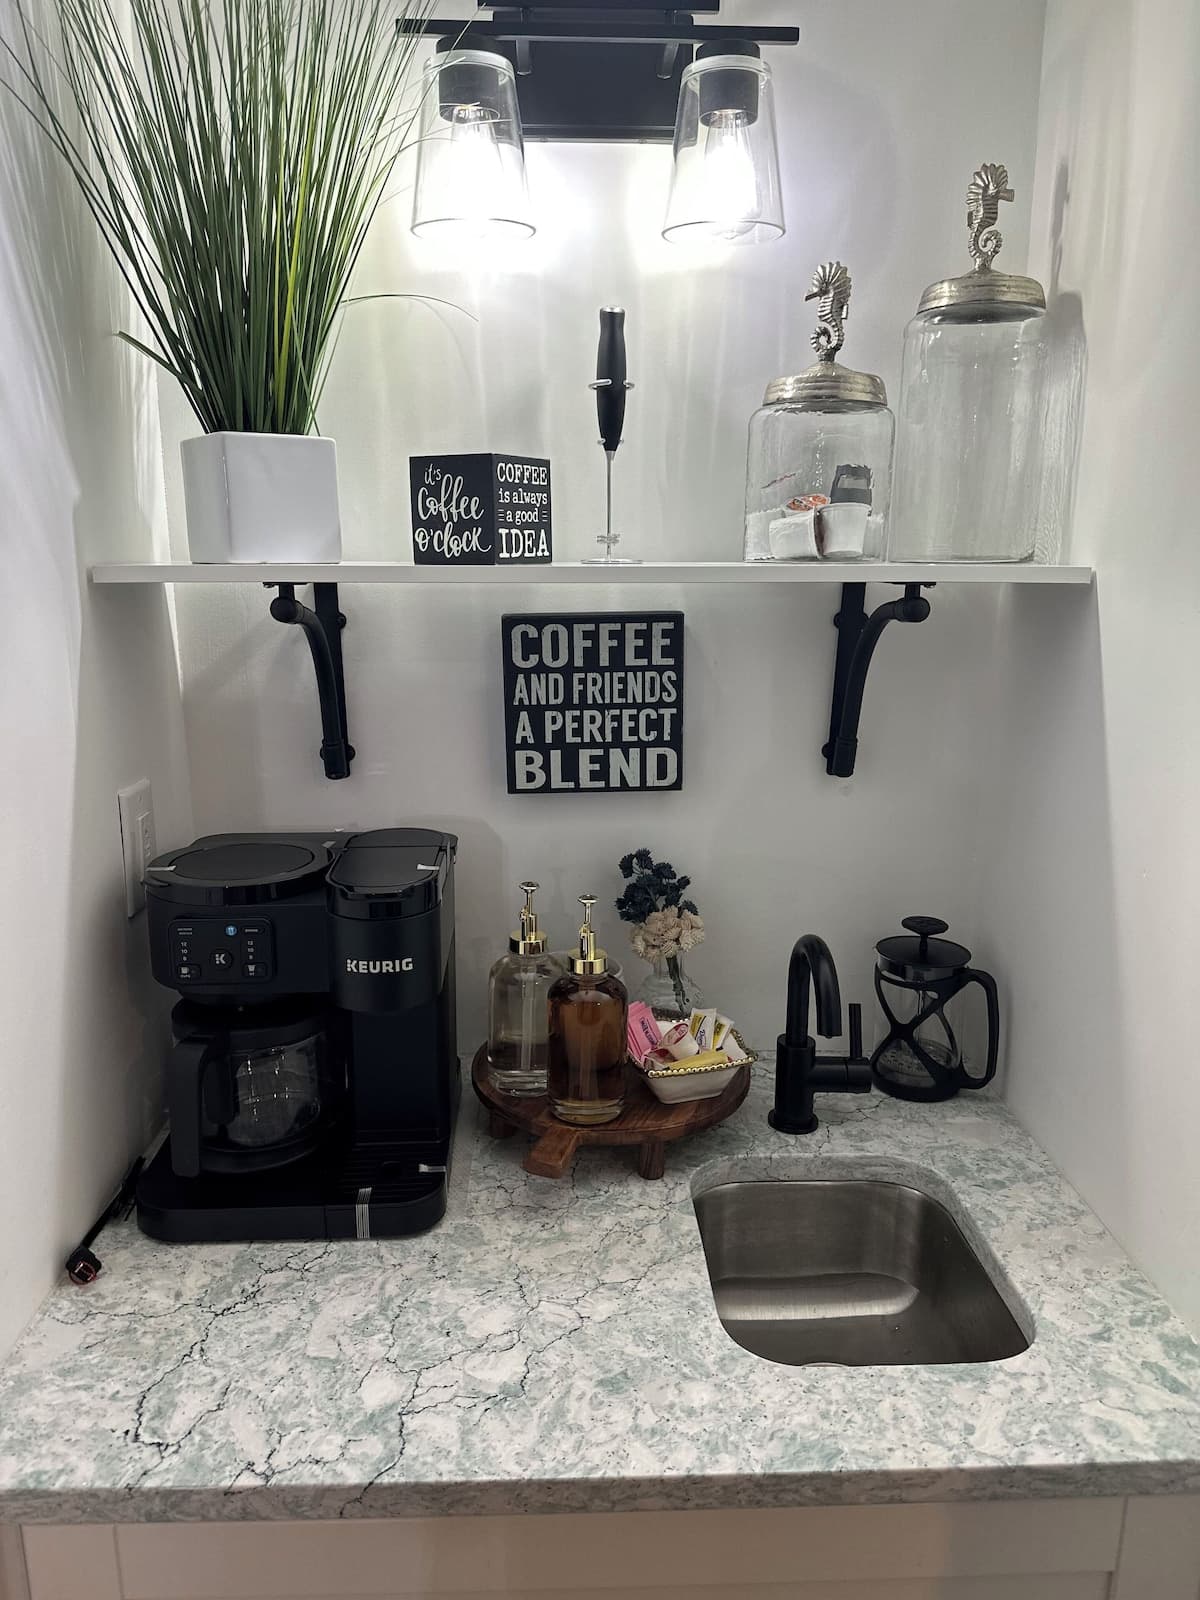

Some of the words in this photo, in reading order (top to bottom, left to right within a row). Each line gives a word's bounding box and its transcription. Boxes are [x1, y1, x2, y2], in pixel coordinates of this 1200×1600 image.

[424, 463, 442, 486] it's
[496, 462, 548, 485] COFFEE
[417, 473, 485, 523] Coffee
[498, 487, 511, 504] is
[512, 487, 548, 508] always
[506, 512, 514, 522] a
[514, 507, 540, 526] good
[498, 528, 550, 559] IDEA
[510, 621, 675, 669] COFFEE
[512, 672, 565, 706] AND
[572, 670, 678, 705] FRIENDS
[515, 710, 535, 745] A
[544, 707, 678, 744] PERFECT
[514, 747, 678, 790] BLEND
[346, 957, 414, 974] KEURIG
